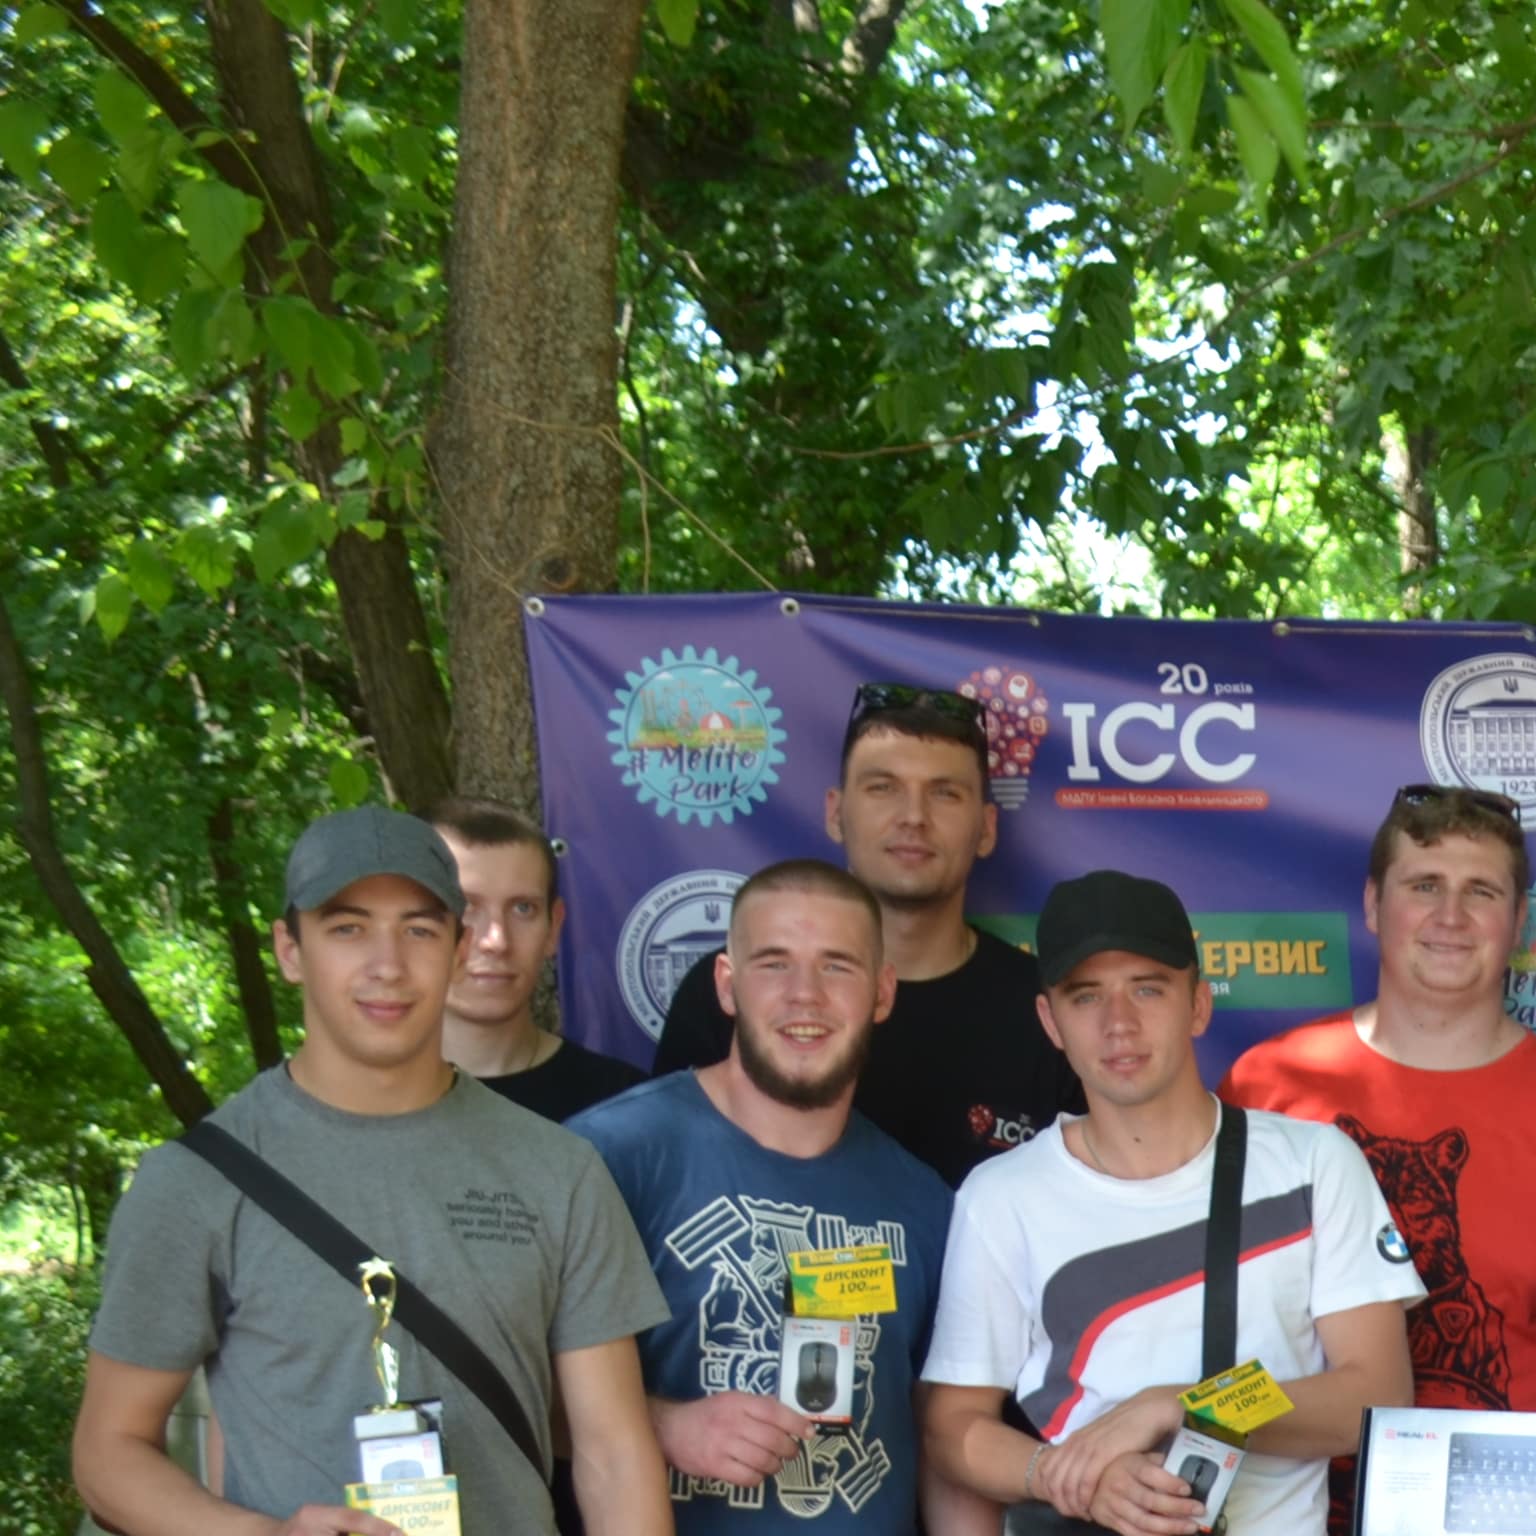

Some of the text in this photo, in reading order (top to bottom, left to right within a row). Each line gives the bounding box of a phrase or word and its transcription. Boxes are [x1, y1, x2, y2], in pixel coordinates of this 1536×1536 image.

[1157, 662, 1208, 695] 20
[660, 742, 757, 774] Melito
[669, 775, 749, 802] Park
